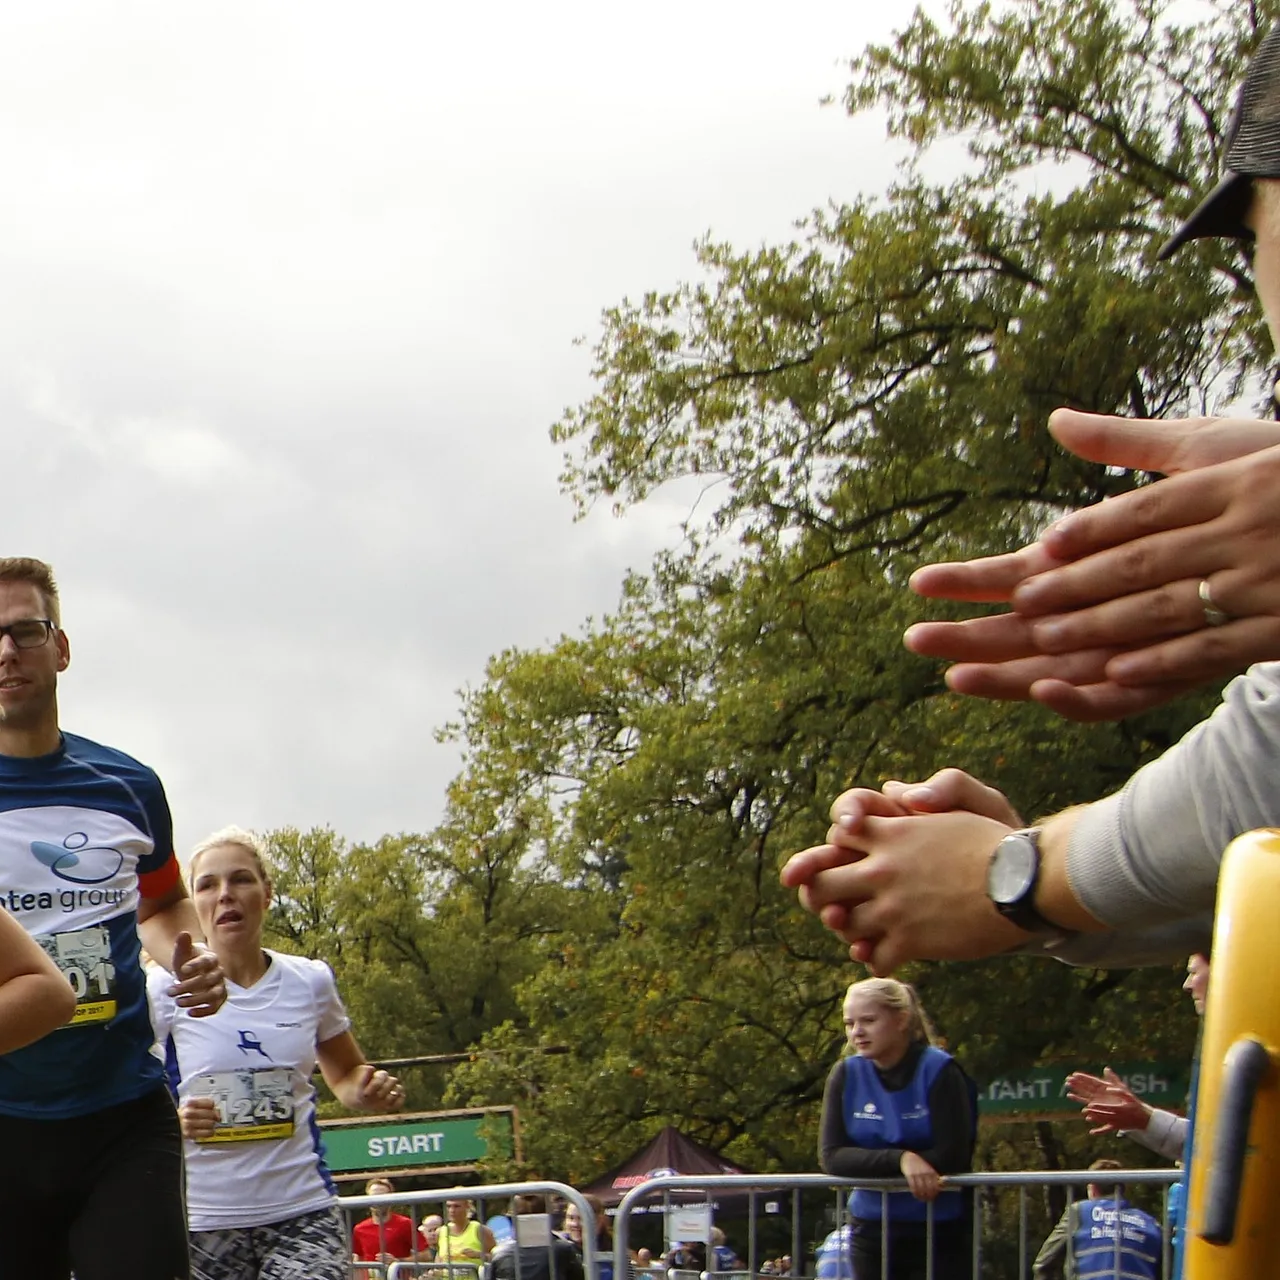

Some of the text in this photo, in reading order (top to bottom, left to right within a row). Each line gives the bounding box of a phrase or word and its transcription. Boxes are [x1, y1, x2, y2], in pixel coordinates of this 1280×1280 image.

[65, 962, 109, 998] 01
[978, 1079, 1052, 1101] TART
[219, 1096, 293, 1124] 1243
[367, 1133, 444, 1157] START
